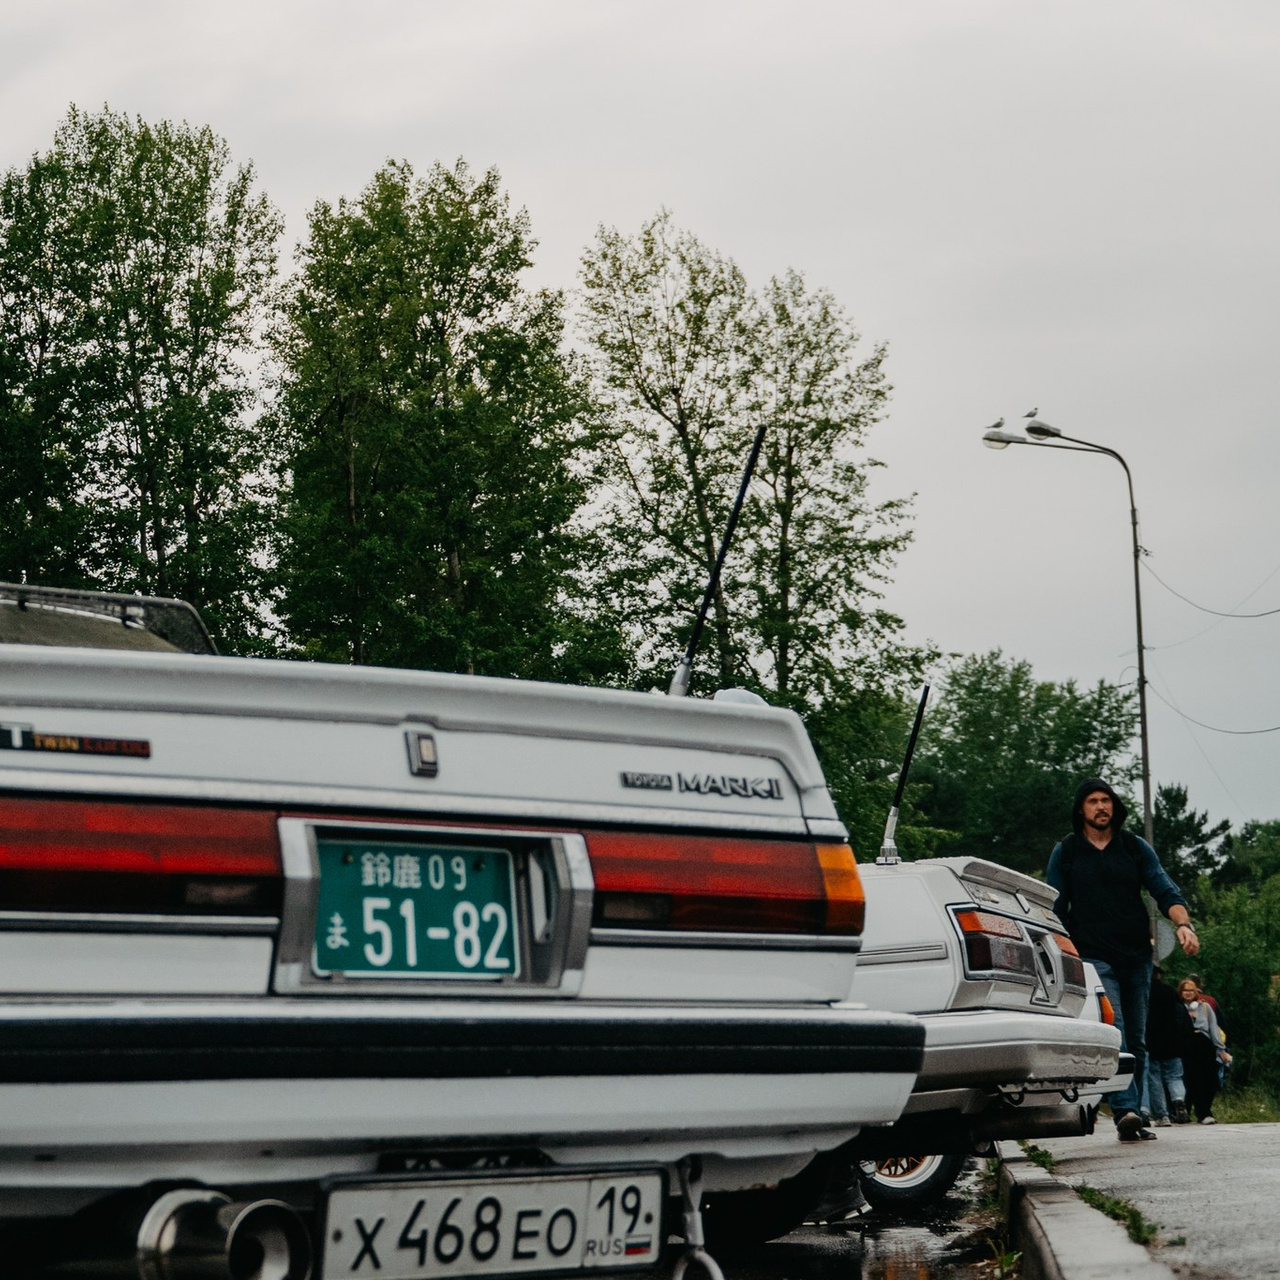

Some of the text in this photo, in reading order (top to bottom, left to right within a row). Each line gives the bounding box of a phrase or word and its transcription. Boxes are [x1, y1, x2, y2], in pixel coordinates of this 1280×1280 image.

[626, 773, 671, 789] TOYOTA
[428, 854, 467, 891] 09
[325, 896, 511, 969] ま 51-82
[597, 1185, 641, 1235] 19
[586, 1237, 624, 1257] RUS
